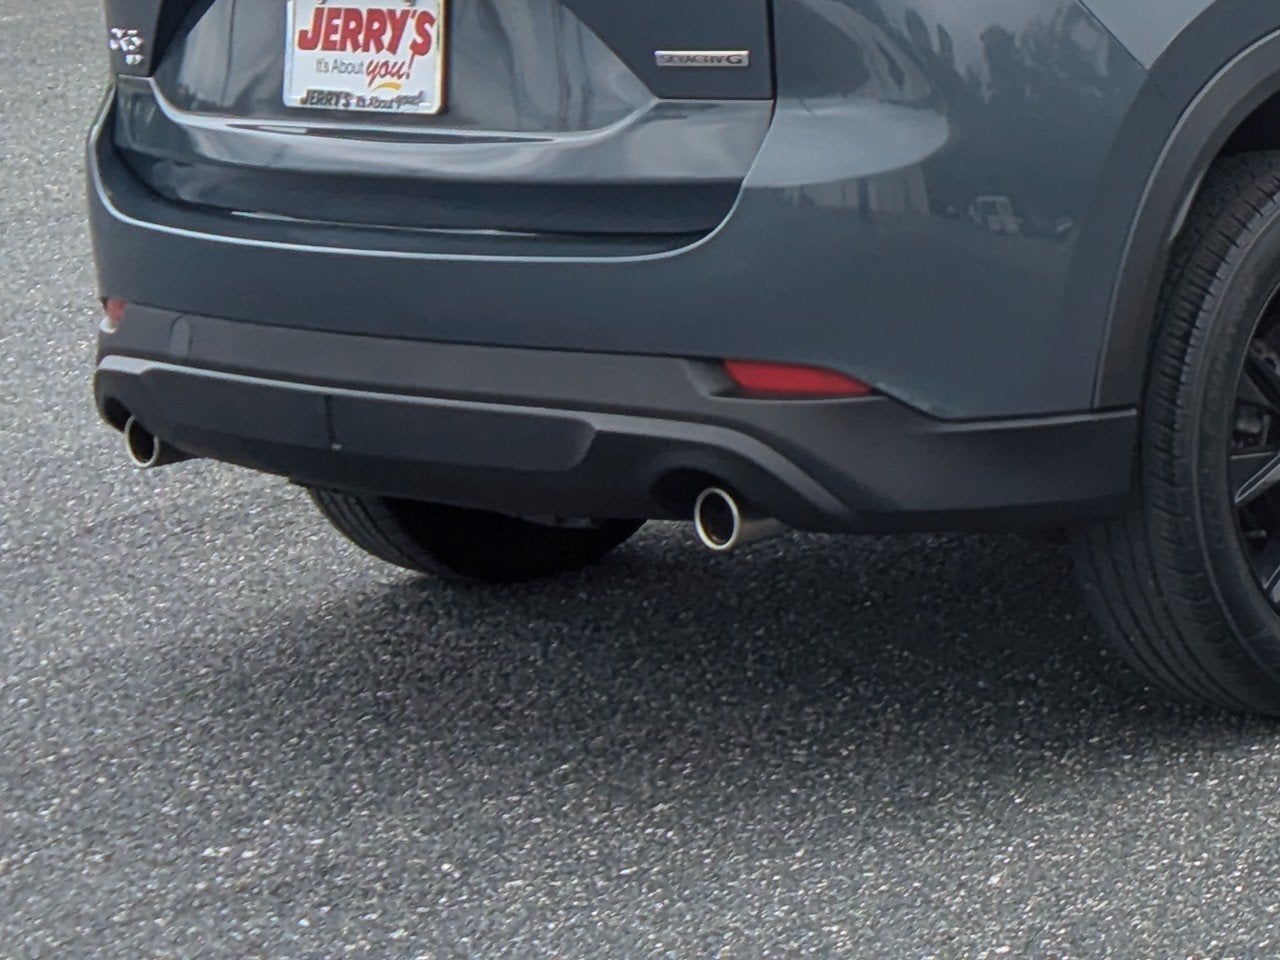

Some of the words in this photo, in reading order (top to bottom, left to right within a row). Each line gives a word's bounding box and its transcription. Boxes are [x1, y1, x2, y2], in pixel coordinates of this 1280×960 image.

[297, 7, 436, 56] JERRY'S
[332, 58, 364, 75] About
[365, 54, 415, 88] you!
